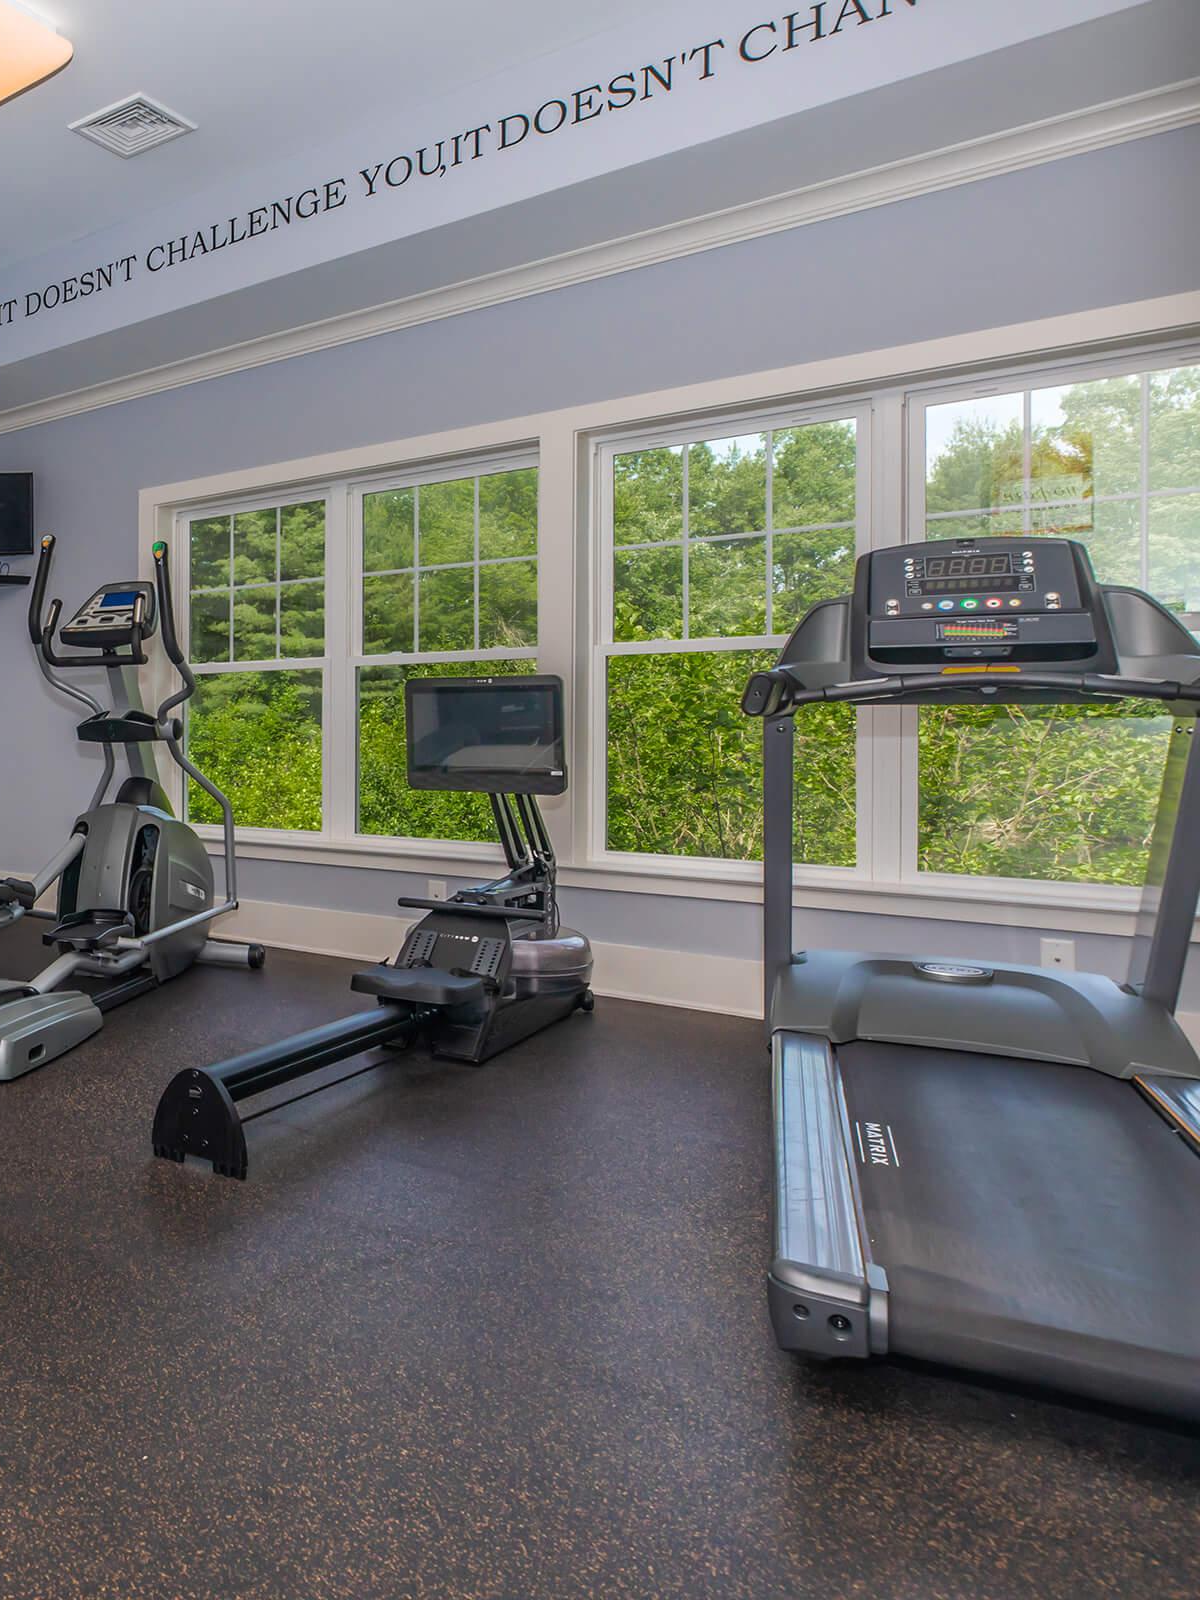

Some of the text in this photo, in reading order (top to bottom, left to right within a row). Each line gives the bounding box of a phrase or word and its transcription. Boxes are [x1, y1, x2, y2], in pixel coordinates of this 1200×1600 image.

[24, 254, 138, 318] DOESN'T
[146, 177, 347, 272] CHALLENGE
[496, 38, 725, 151] DOESN'T
[864, 1121, 889, 1166] MATRIX
